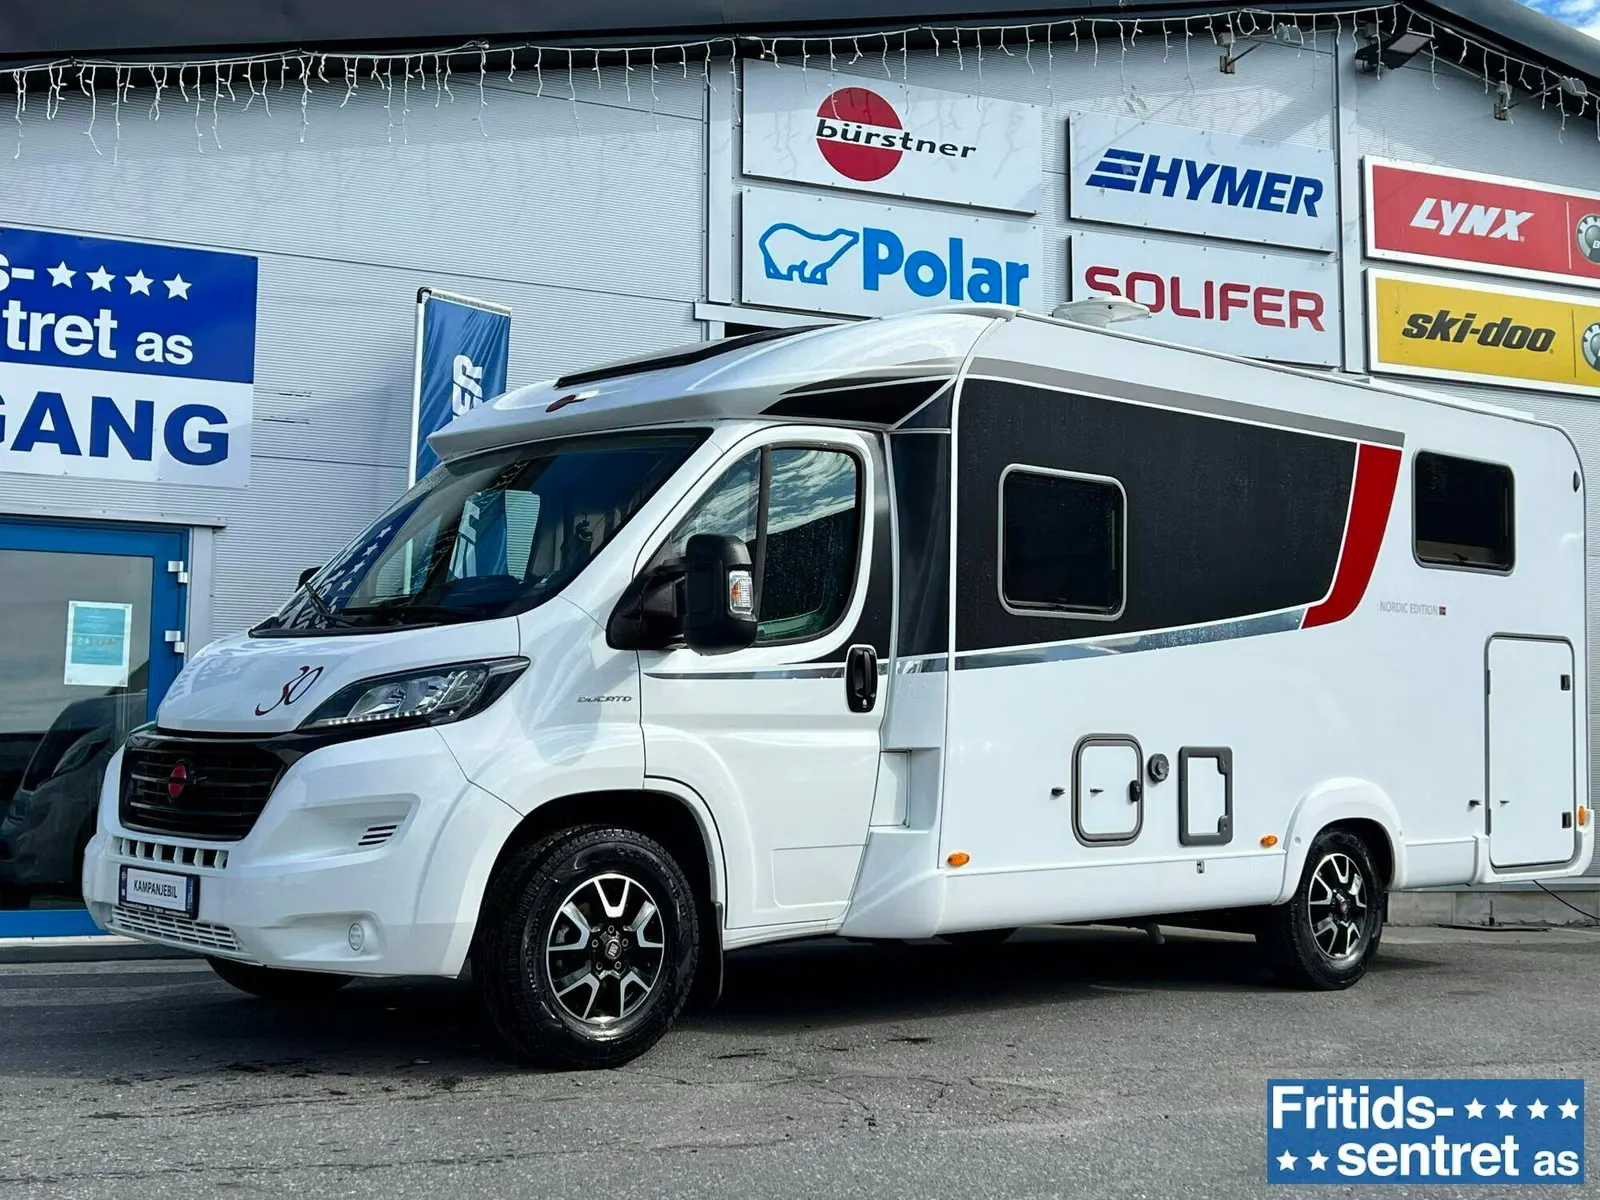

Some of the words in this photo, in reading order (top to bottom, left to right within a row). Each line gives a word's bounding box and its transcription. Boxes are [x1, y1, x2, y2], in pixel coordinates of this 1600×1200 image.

[816, 119, 976, 158] bürstner
[1139, 154, 1324, 218] HYMER
[1409, 197, 1535, 241] LYNX
[862, 226, 1029, 306] Polar
[1084, 265, 1326, 332] SOLIFER
[135, 331, 194, 365] as
[1401, 309, 1556, 353] ski-doo
[452, 354, 483, 421] ER
[1379, 601, 1408, 613] NORDIC
[1410, 603, 1438, 616] EDITION
[577, 695, 632, 703] DUCATO
[133, 880, 178, 898] KAMPANJEBIL
